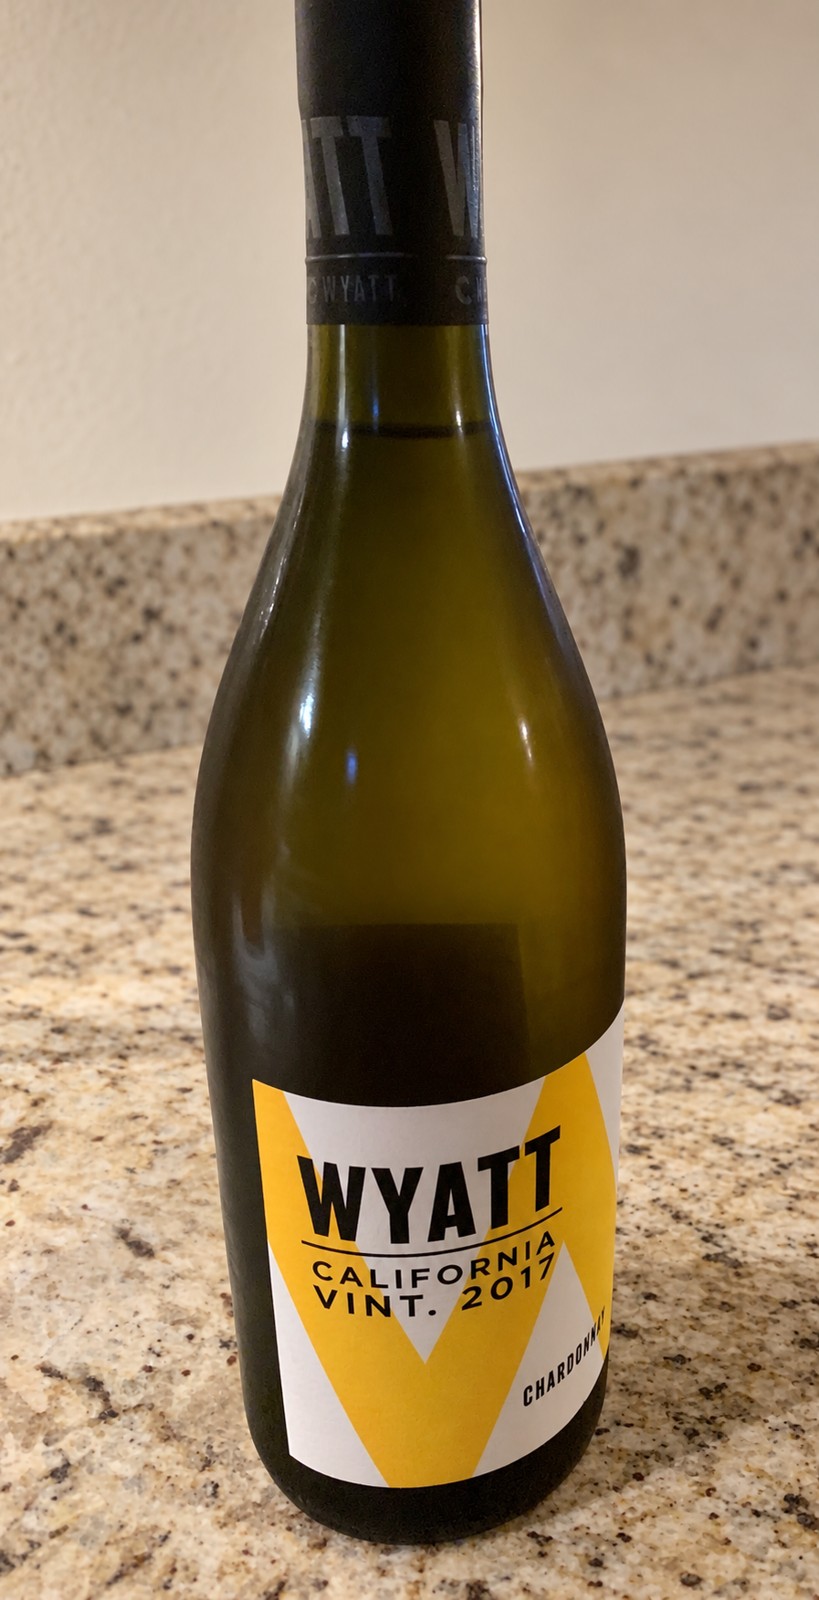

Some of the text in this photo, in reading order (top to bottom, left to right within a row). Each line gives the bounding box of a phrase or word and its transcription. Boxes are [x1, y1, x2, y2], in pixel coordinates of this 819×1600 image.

[297, 1125, 561, 1244] WYATT
[312, 1231, 555, 1289] CALIFORNIA
[313, 1252, 555, 1317] VINT. 2017
[522, 1305, 605, 1407] CHARDONNAY
